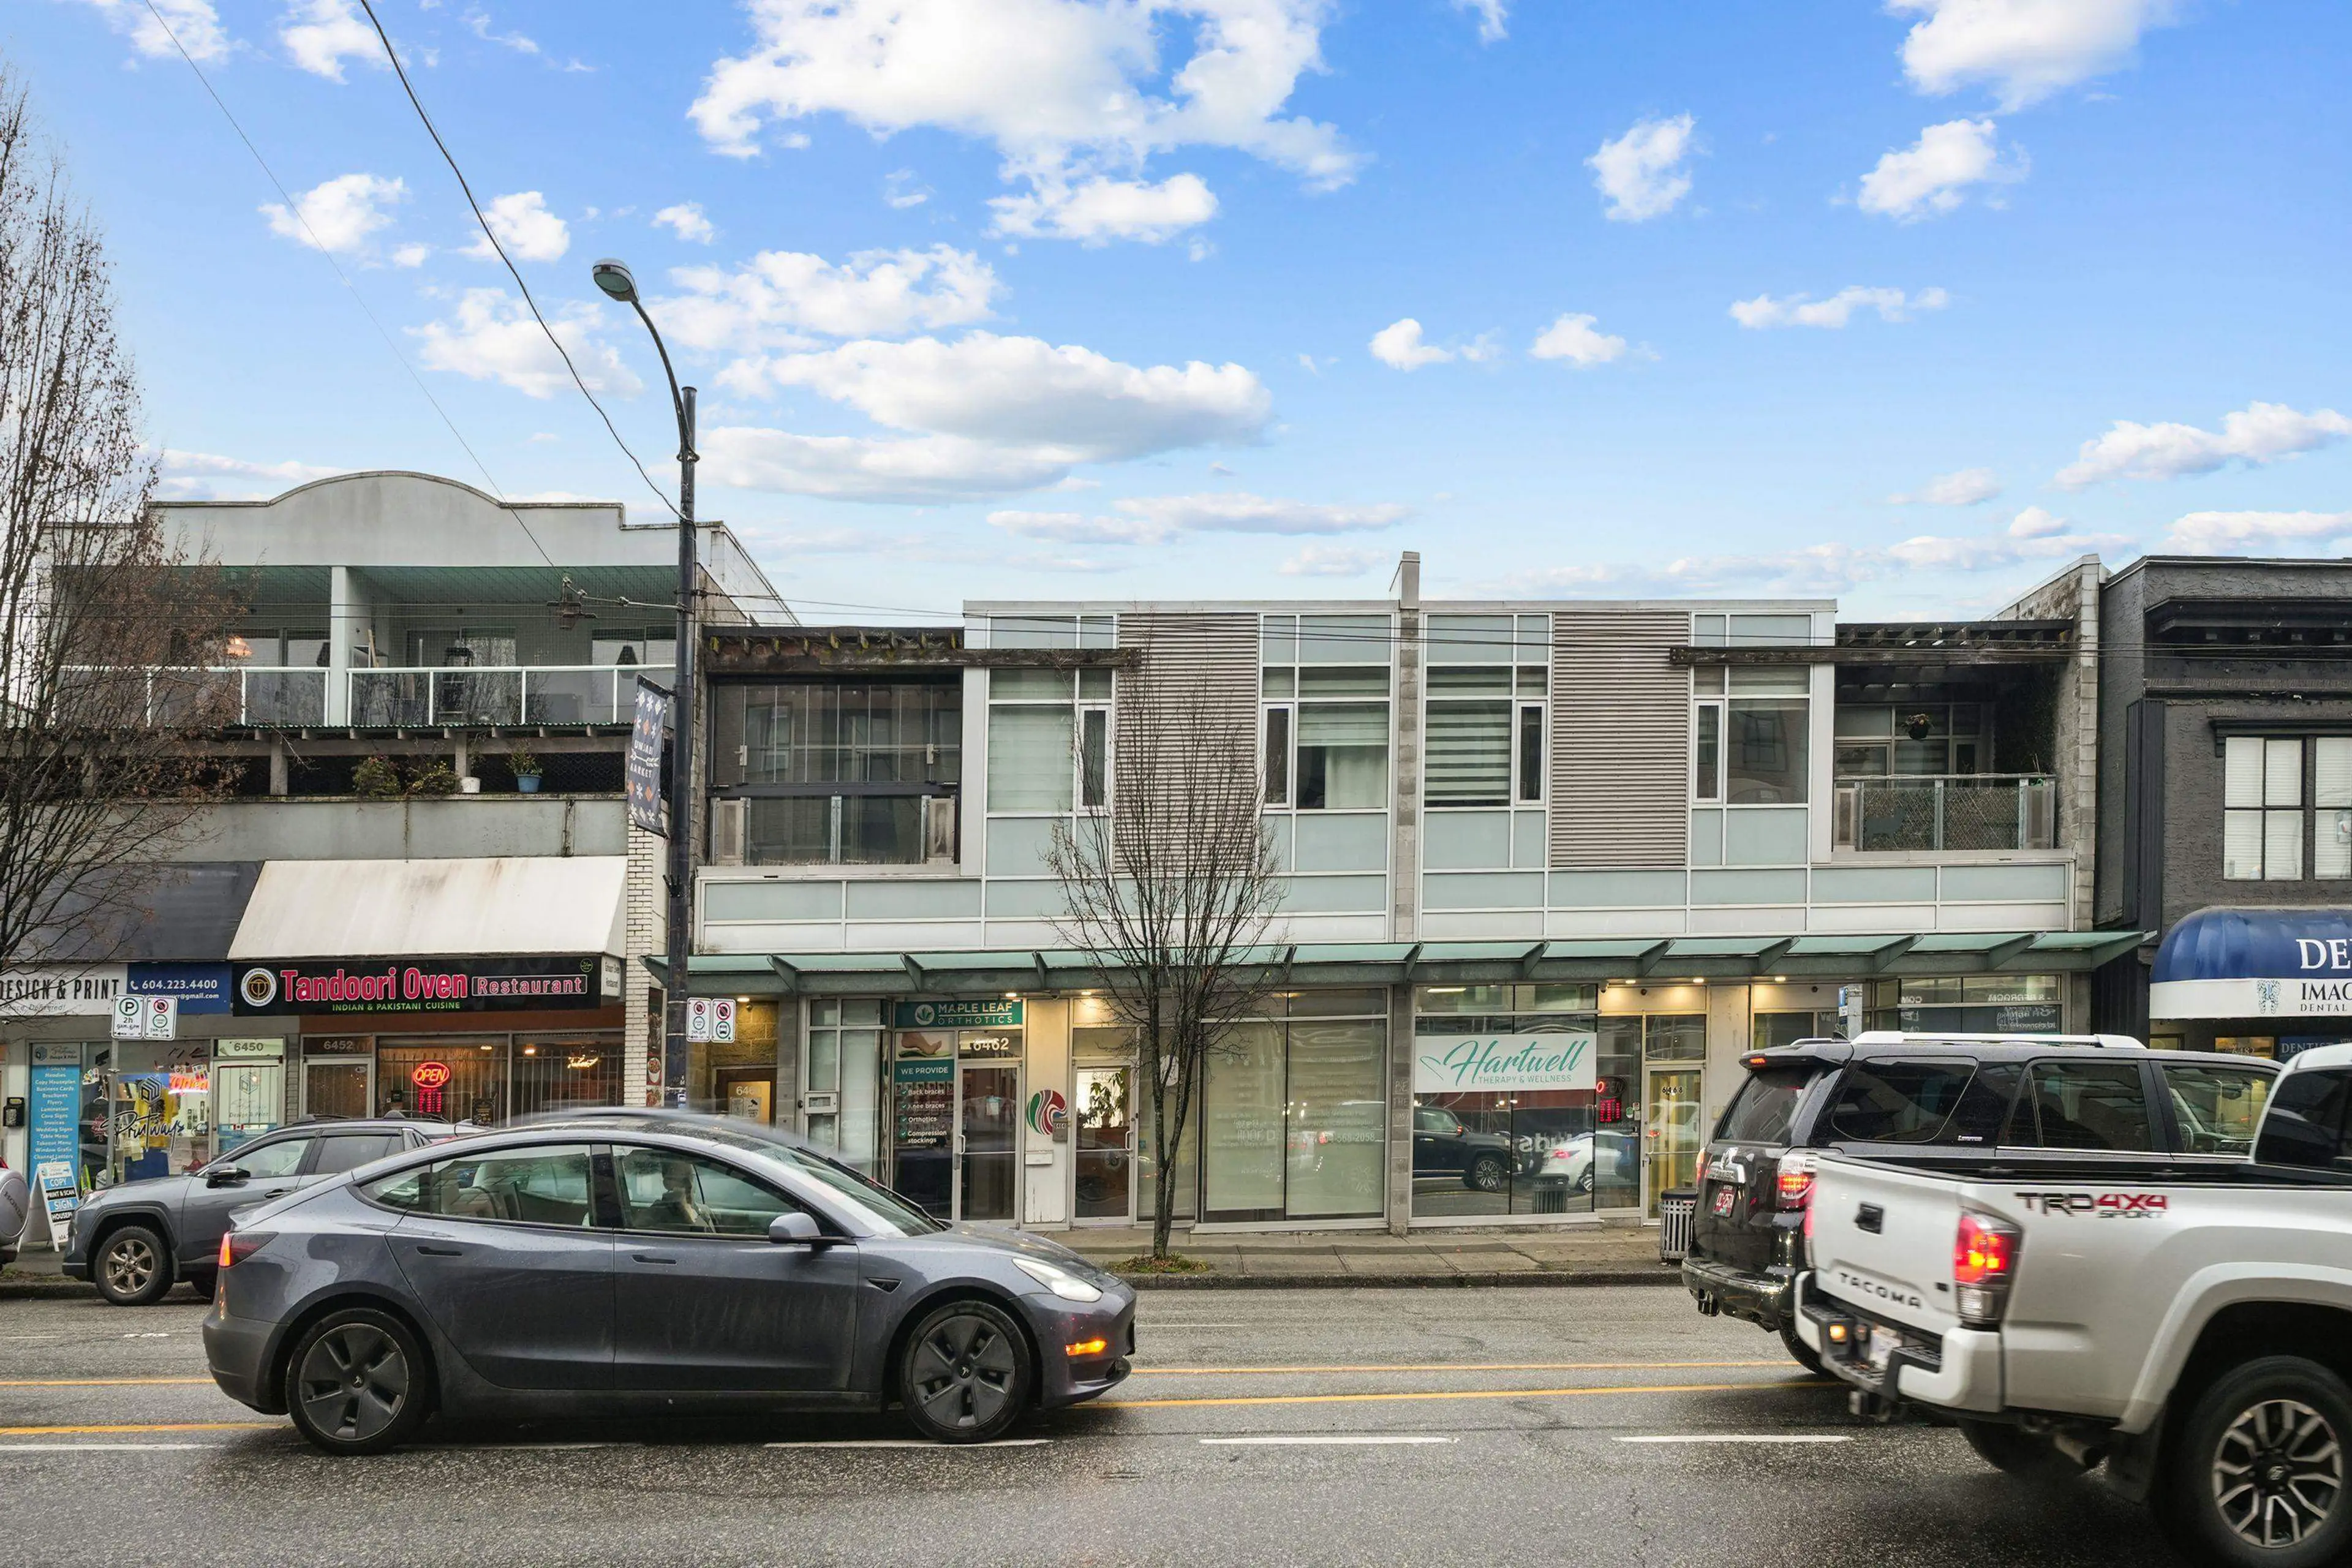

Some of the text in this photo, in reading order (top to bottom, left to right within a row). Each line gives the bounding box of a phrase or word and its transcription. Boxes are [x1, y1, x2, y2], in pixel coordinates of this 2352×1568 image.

[2296, 938, 2352, 969] DE
[57, 979, 66, 1000] &
[74, 979, 119, 1000] PRINT
[141, 979, 217, 990] 604.223.4400
[280, 967, 396, 1001] Tandoori
[404, 967, 468, 1000] Oven
[477, 977, 582, 994] Restaurant
[125, 1002, 134, 1012] P
[938, 1002, 1012, 1013] MAPLE LEAF
[2301, 1003, 2347, 1012] DENTAL
[938, 1015, 1013, 1025] ORTHOTICS
[234, 1042, 264, 1051] 6450
[323, 1041, 353, 1049] 6452
[973, 1037, 1009, 1050] 6462
[1443, 1040, 1588, 1087] Hartwell
[415, 1068, 446, 1082] OPEN
[1479, 1076, 1517, 1084] THERAPY
[1527, 1074, 1572, 1083] WELLNESS
[1596, 1080, 1624, 1093] OPEN
[50, 1178, 67, 1186] COPY
[54, 1199, 73, 1209] SIGN
[2015, 1192, 2169, 1216] TRD 4X4
[52, 1212, 73, 1220] HOUSEP
[1839, 1272, 1921, 1310] TACOMA
